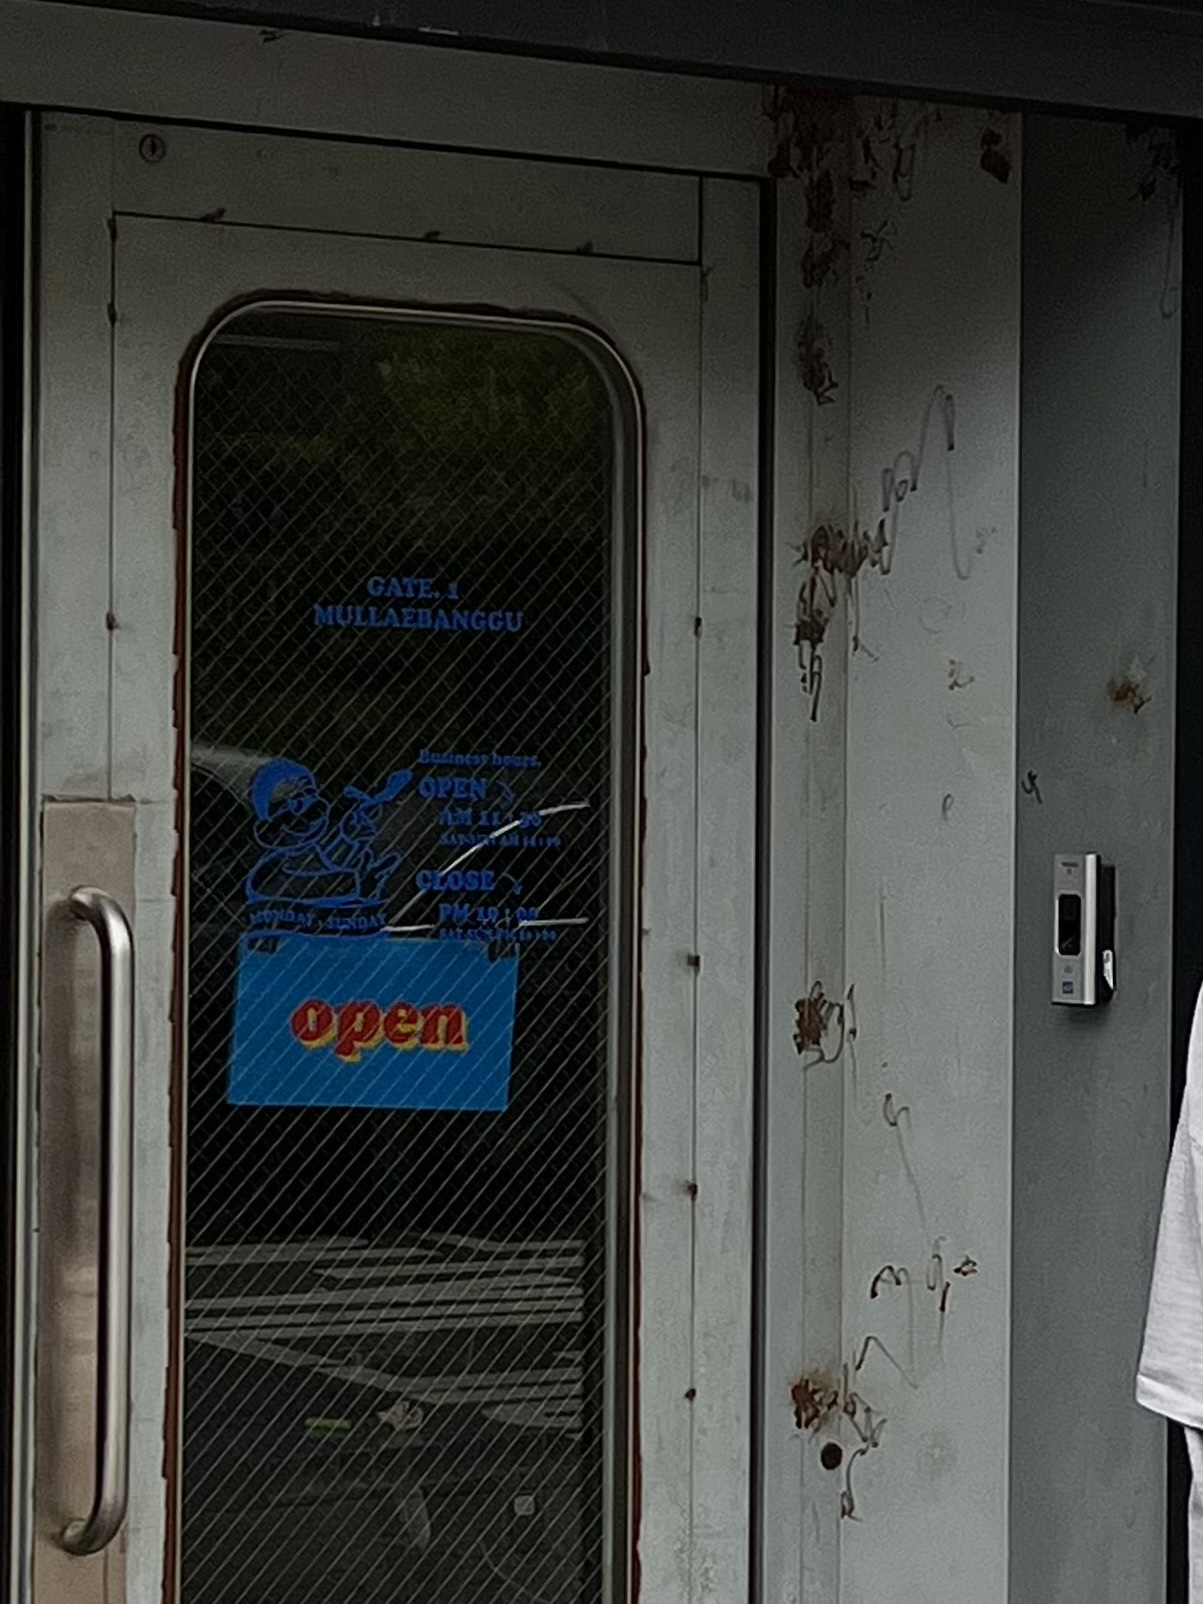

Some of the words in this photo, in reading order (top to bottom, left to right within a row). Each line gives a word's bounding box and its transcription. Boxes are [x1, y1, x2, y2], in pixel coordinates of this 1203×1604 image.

[313, 603, 524, 632] MULLAEBANGGU
[418, 775, 489, 800] OPEN
[415, 869, 496, 893] CLOSE
[289, 996, 470, 1063] open
